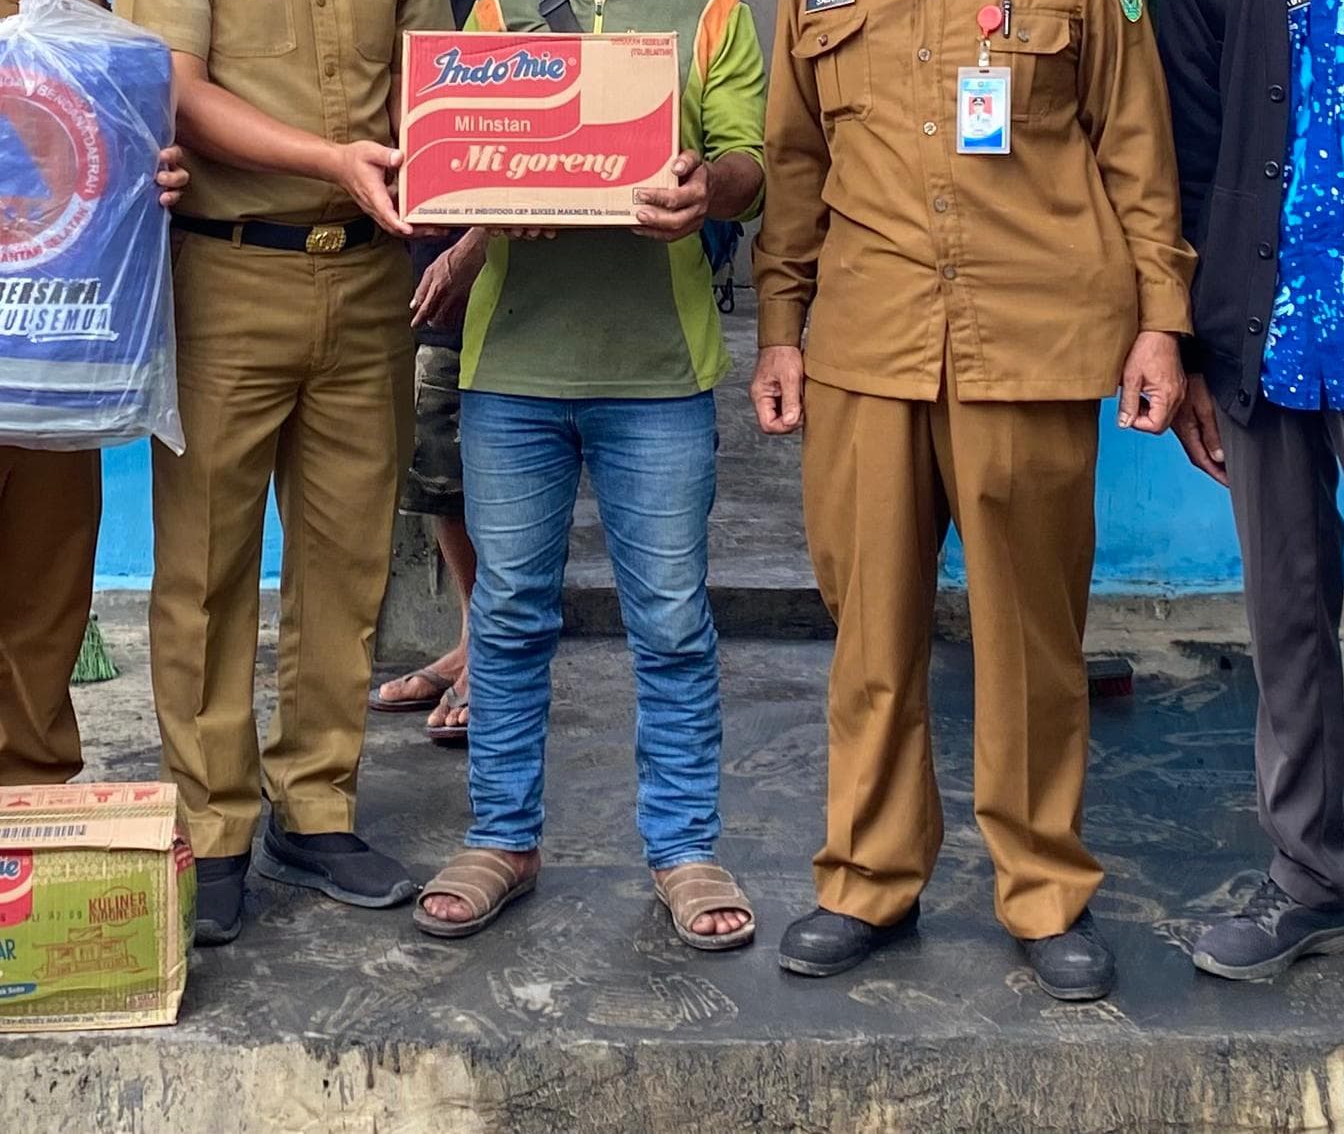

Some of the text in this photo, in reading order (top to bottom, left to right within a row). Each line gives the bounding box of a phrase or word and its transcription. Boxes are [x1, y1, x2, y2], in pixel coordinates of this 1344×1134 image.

[455, 116, 532, 133] Mi Instan
[450, 145, 629, 181] Mi goreng
[35, 307, 108, 331] SEMUA
[88, 891, 147, 913] KULINER
